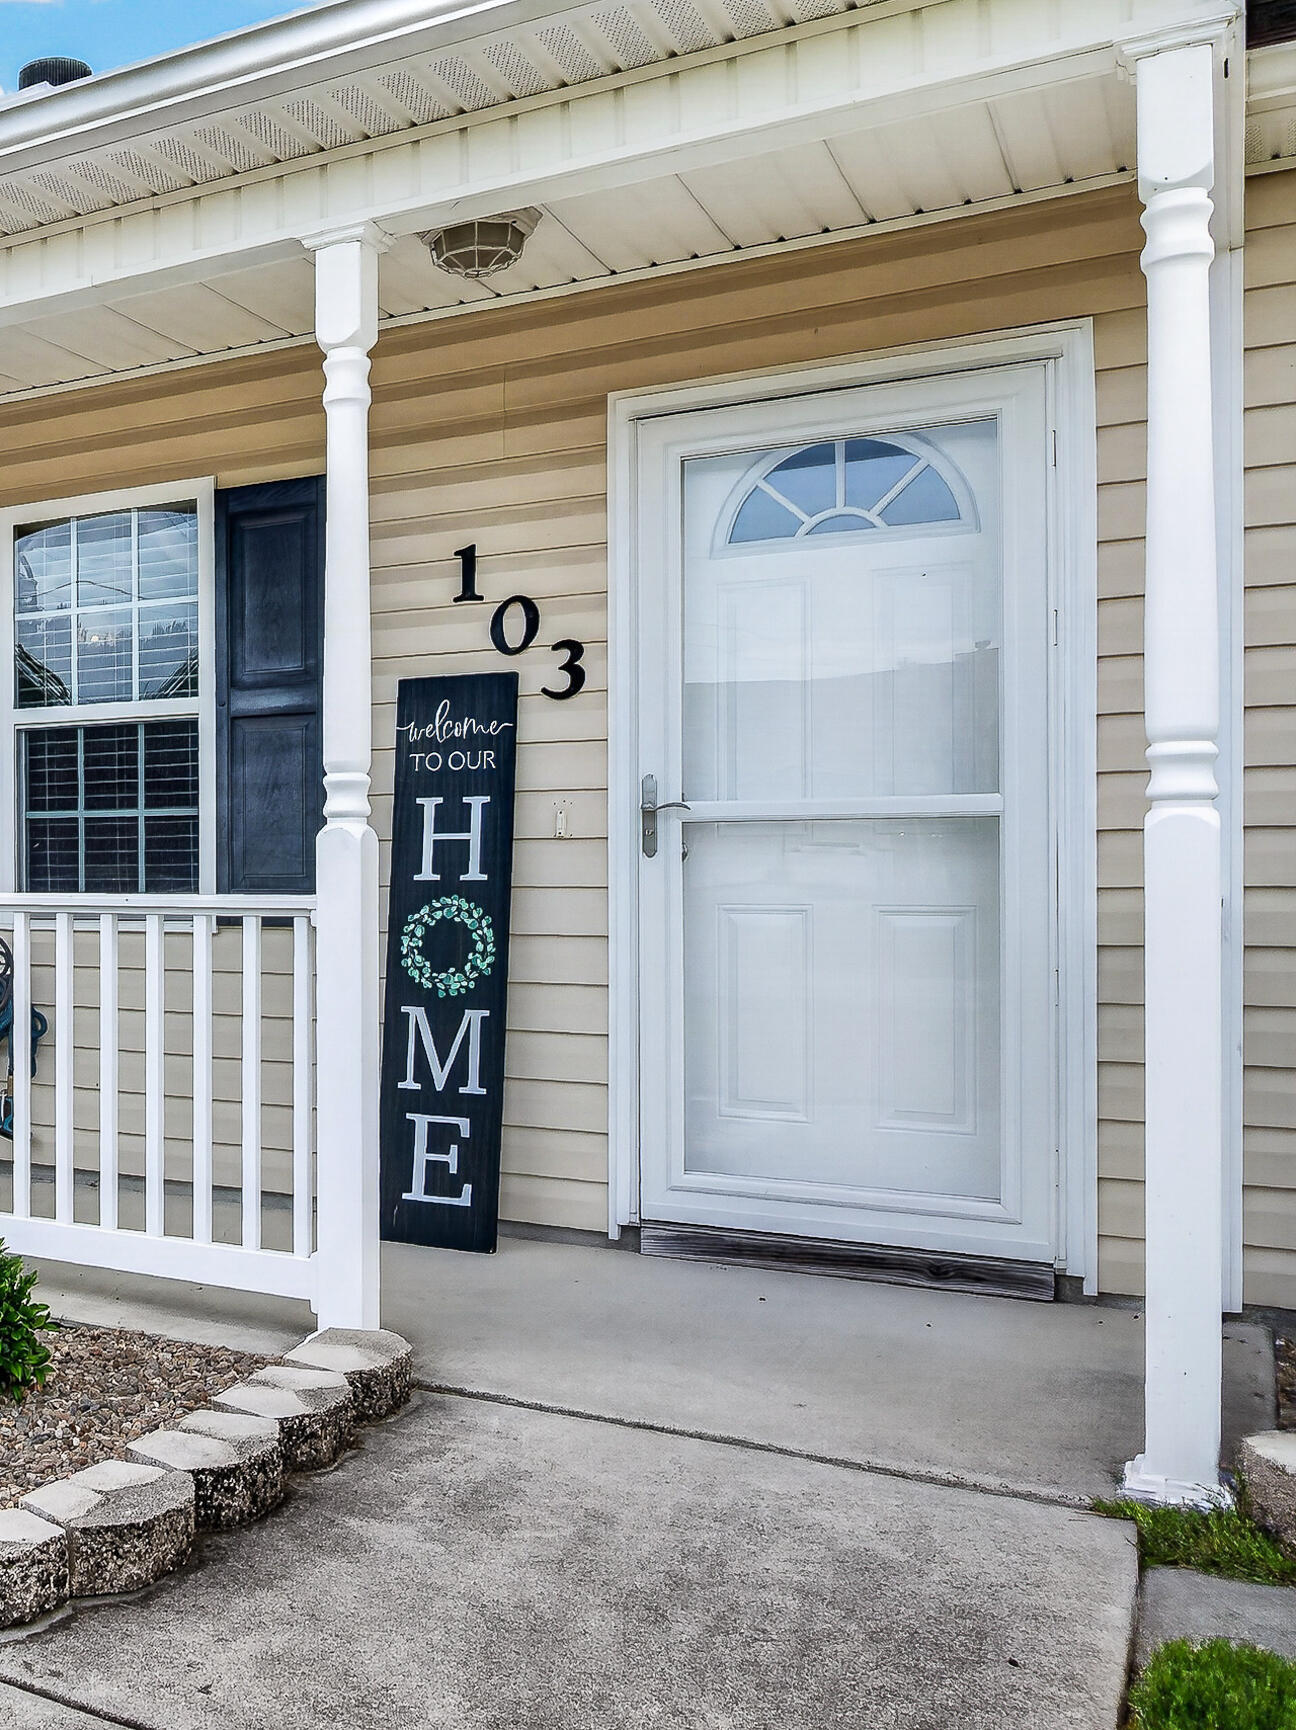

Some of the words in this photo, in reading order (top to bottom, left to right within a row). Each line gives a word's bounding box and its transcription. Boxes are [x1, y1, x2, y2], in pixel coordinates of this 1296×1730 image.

[453, 544, 586, 700] 103
[396, 700, 513, 742] welcome
[410, 752, 443, 772] TO
[448, 750, 496, 771] OUR
